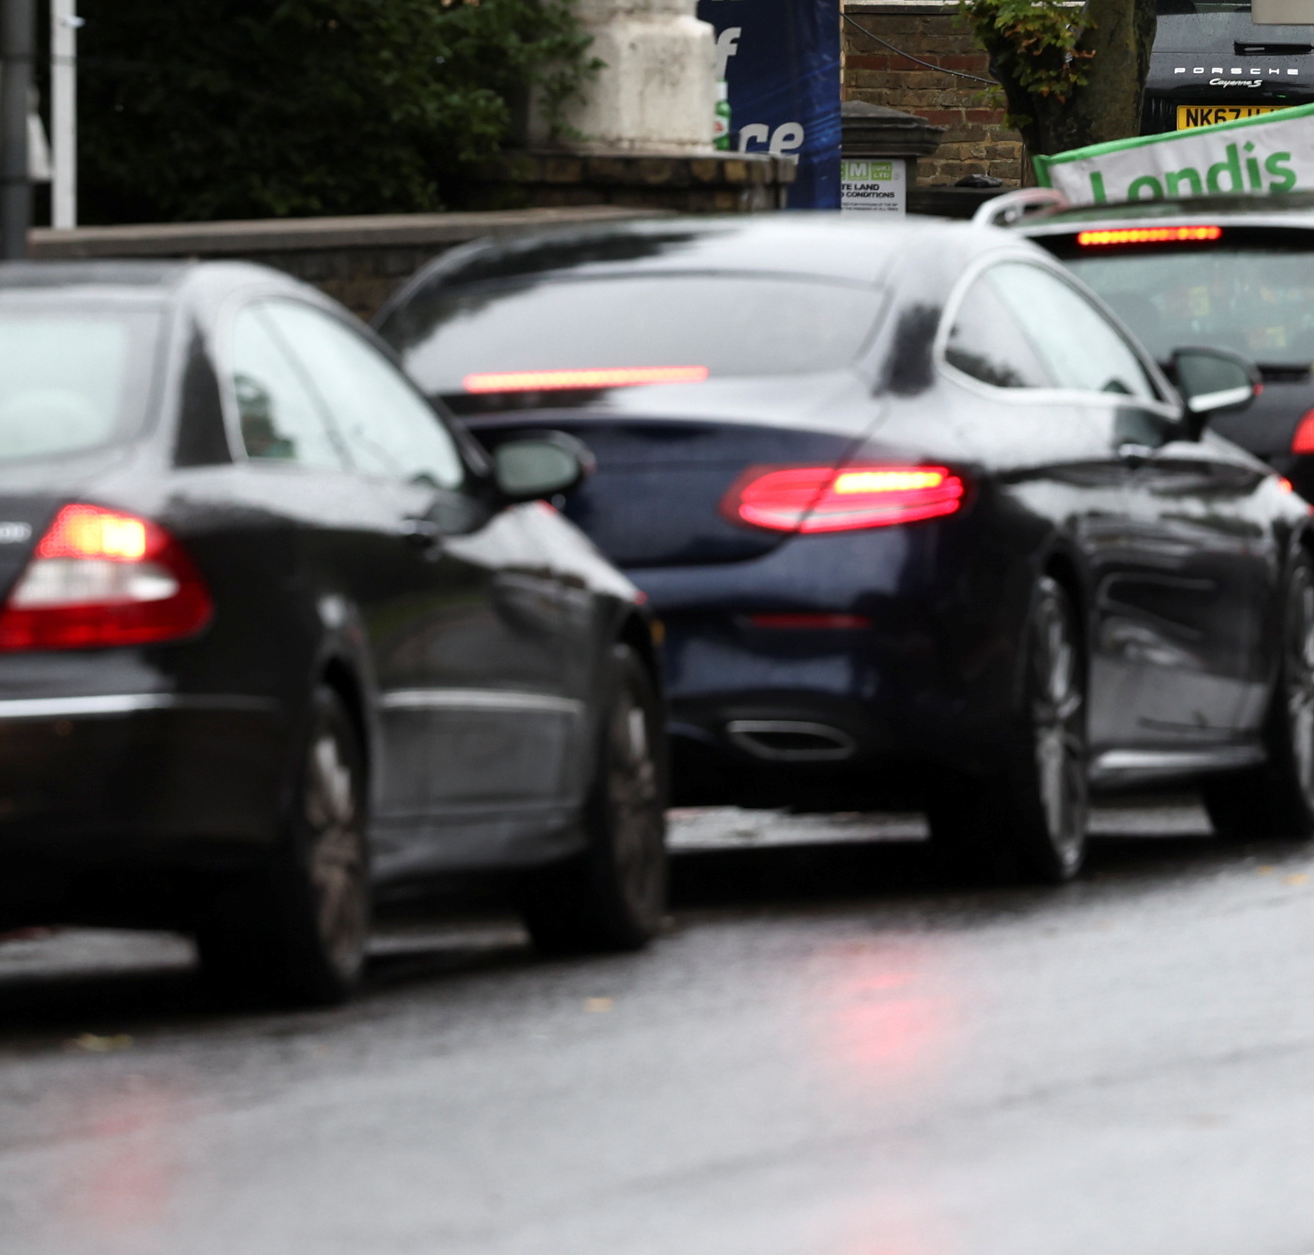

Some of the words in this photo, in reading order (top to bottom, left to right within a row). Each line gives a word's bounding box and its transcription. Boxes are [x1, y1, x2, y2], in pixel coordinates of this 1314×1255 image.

[1174, 67, 1299, 76] PORSCHE
[1209, 78, 1252, 89] Cayenne
[854, 183, 880, 191] LAND
[846, 191, 895, 199] CONDITIONS
